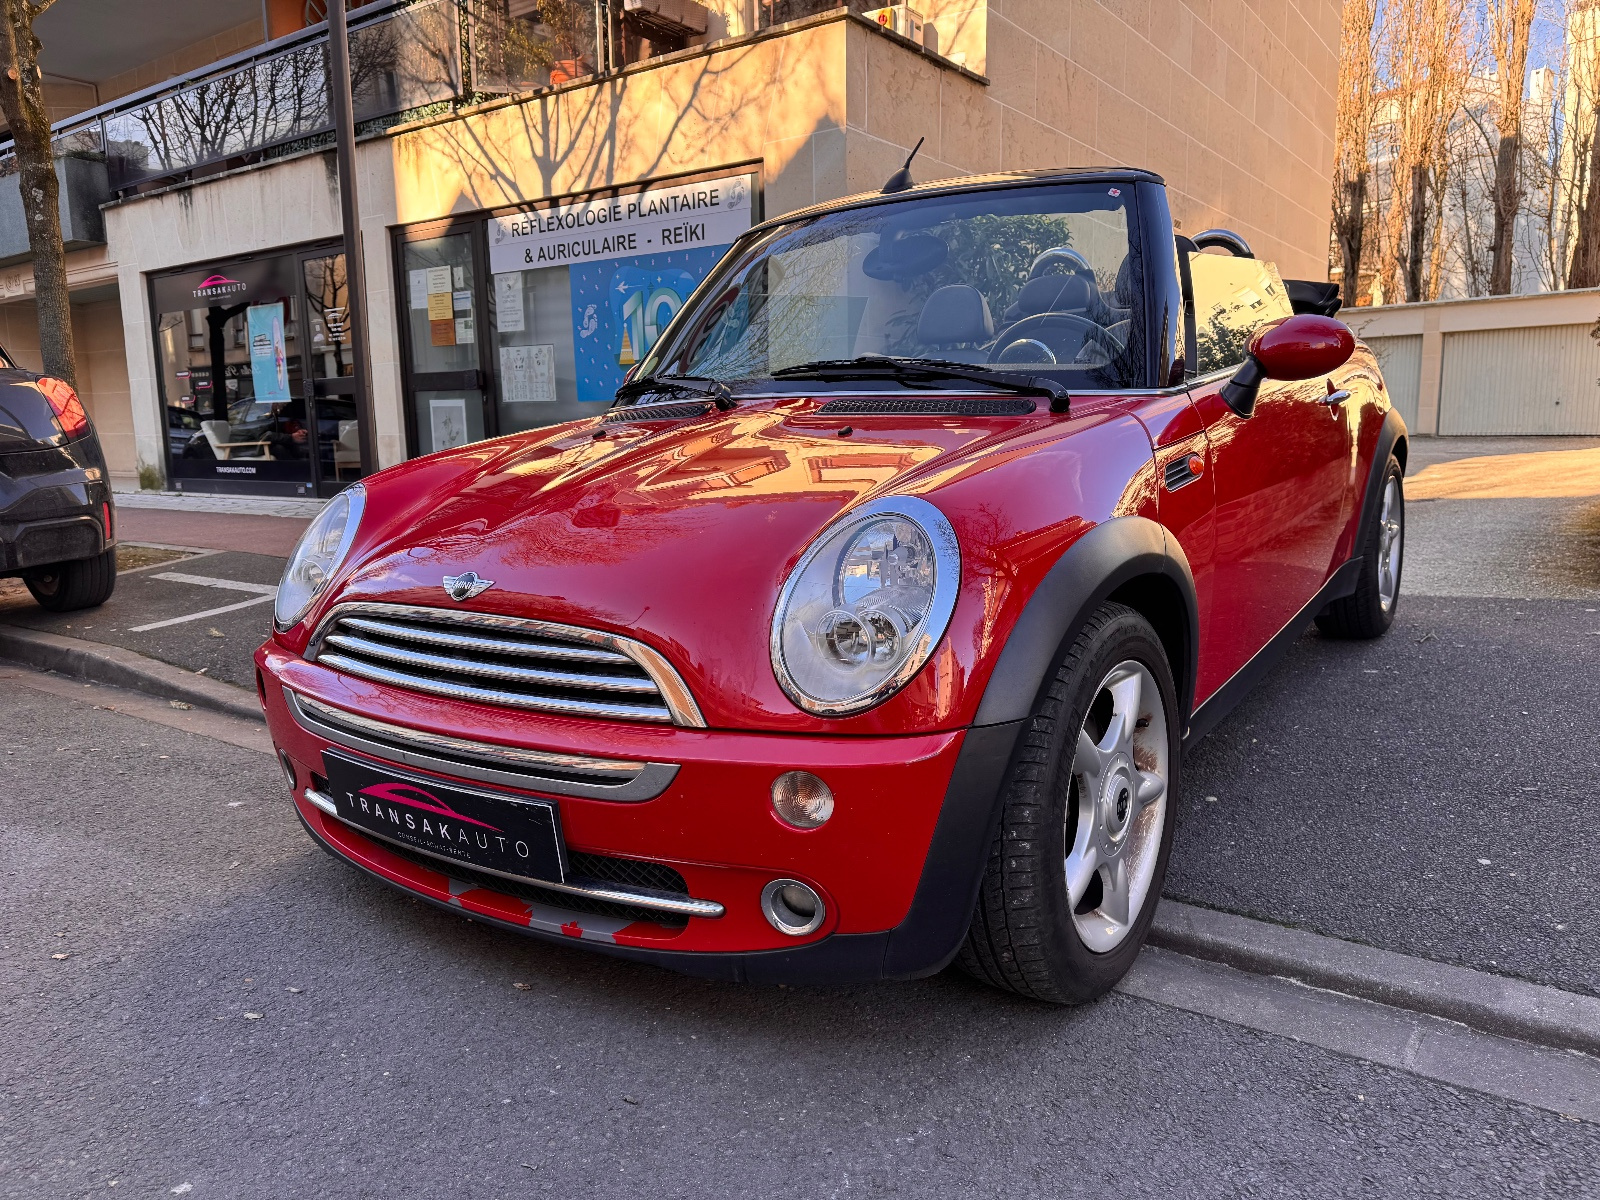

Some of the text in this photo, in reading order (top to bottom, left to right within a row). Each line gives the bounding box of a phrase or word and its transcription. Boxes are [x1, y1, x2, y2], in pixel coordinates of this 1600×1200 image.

[511, 188, 720, 238] RÉFLEXOLOGIE PLANTAIRE
[524, 248, 533, 264] &
[537, 233, 637, 262] AURICULAIRE
[661, 222, 706, 246] REÏKI
[192, 282, 247, 298] TRANSAKAUTO
[215, 466, 257, 474] TRANSAKAUTO.COM
[345, 791, 530, 858] TRANSAKAUTO
